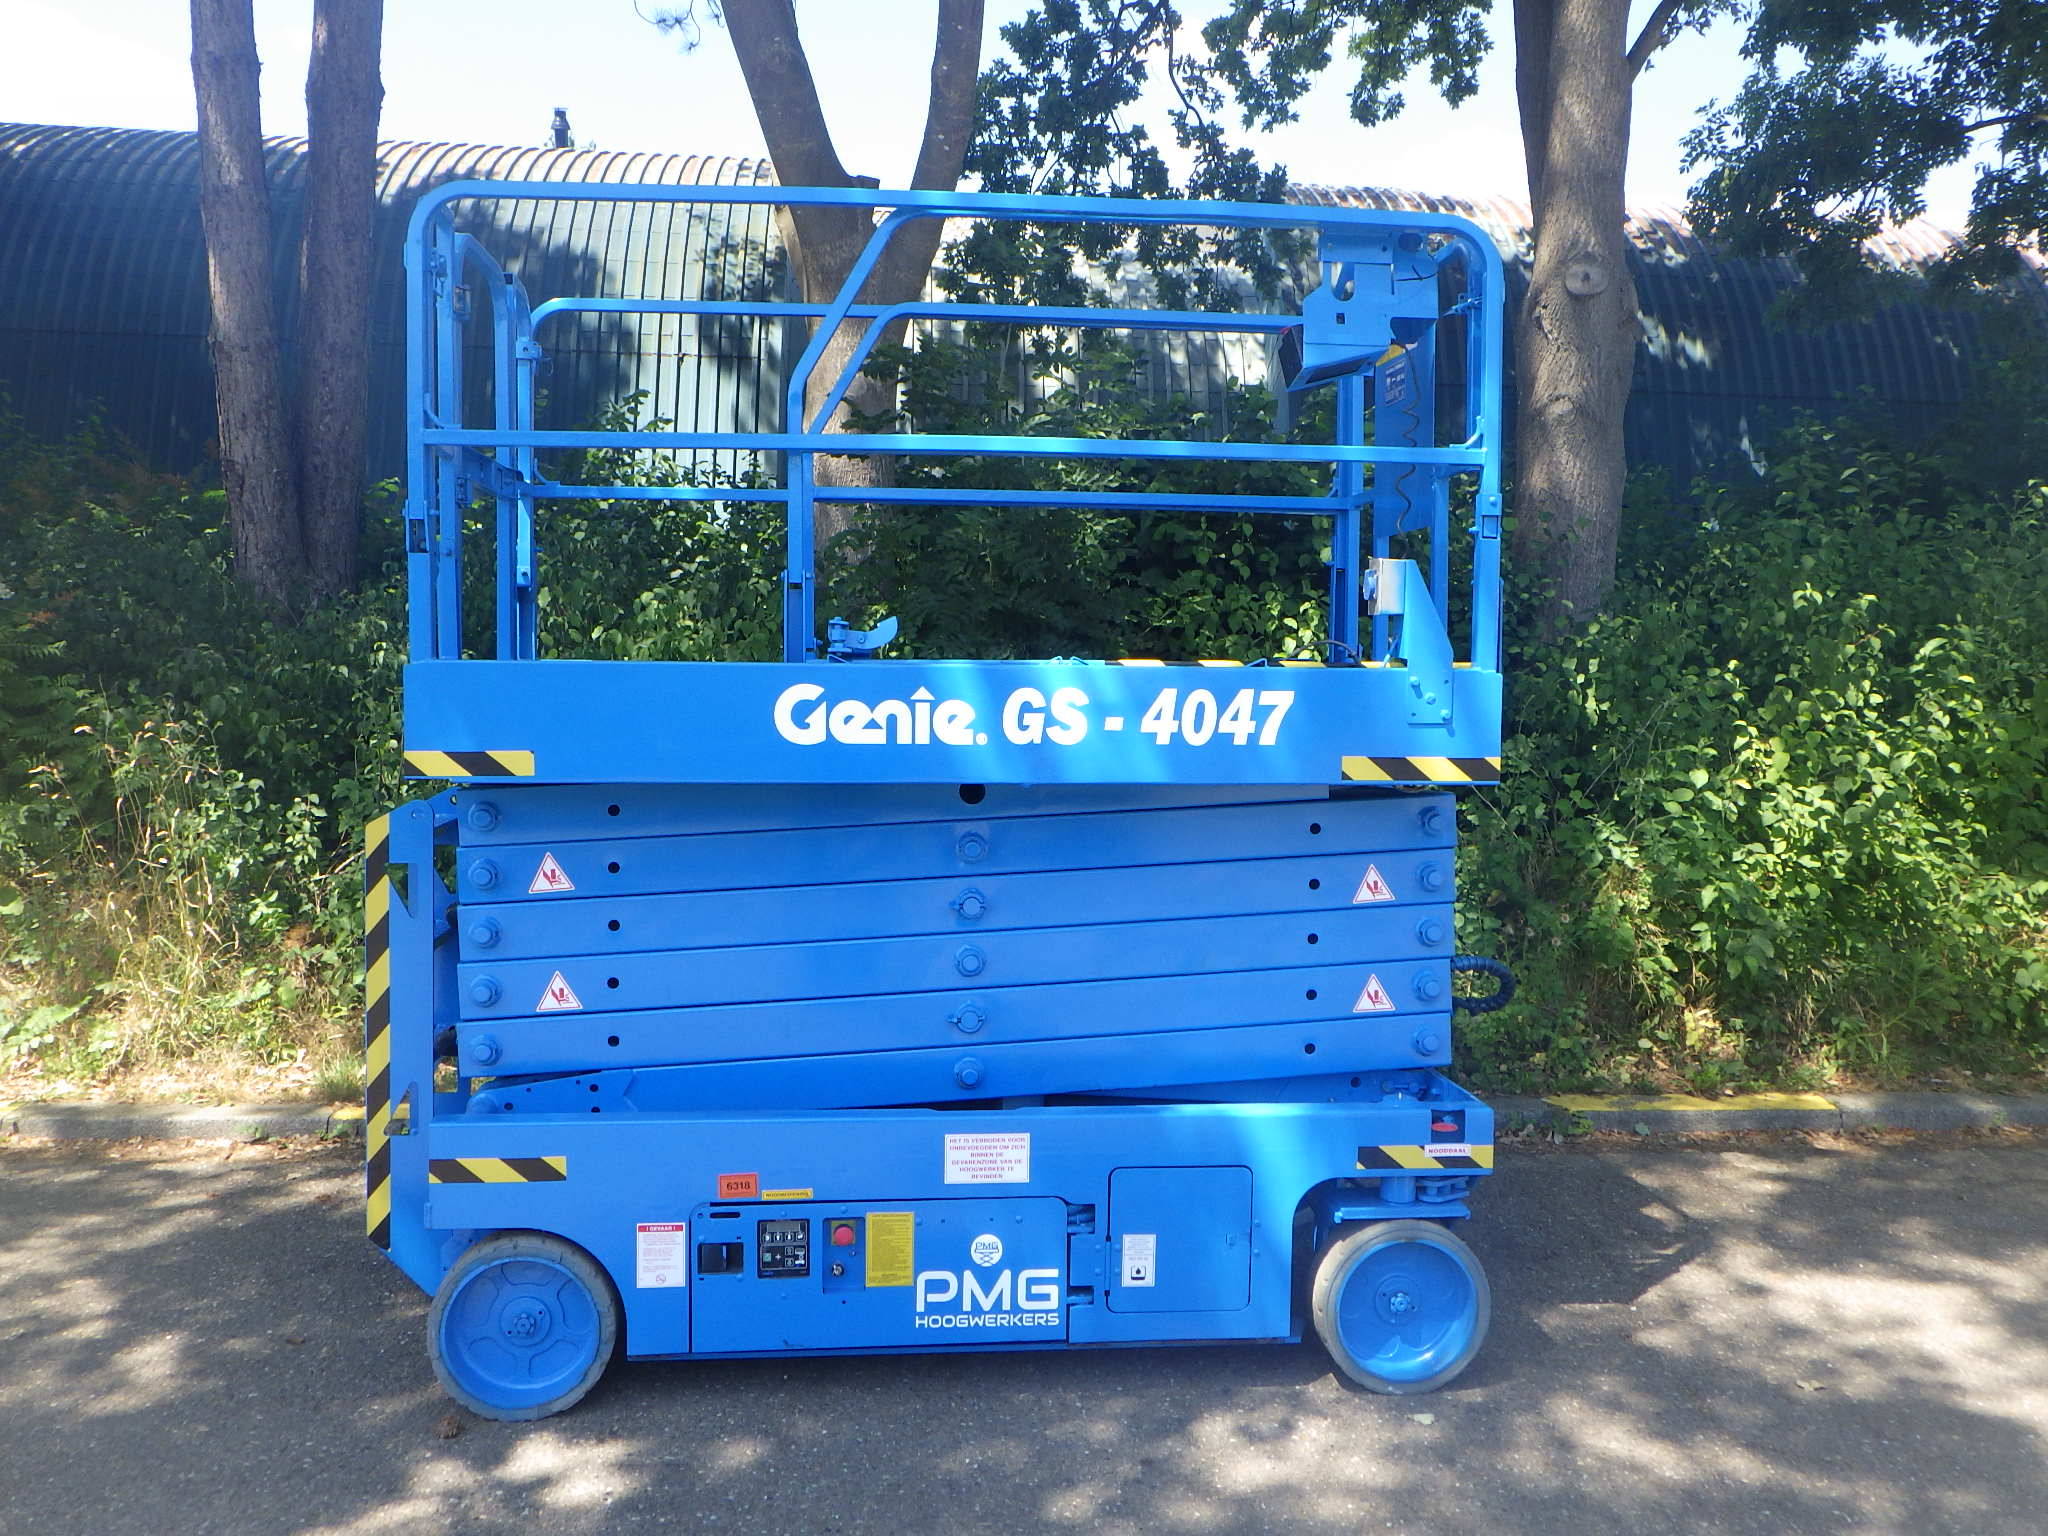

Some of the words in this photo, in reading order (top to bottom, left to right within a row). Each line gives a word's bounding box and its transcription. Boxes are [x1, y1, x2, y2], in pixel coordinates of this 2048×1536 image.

[1140, 688, 1296, 746] 4047
[726, 1181, 751, 1191] 6318
[916, 1269, 1059, 1312] PMG
[916, 1313, 1059, 1328] HOOGWERKERS
